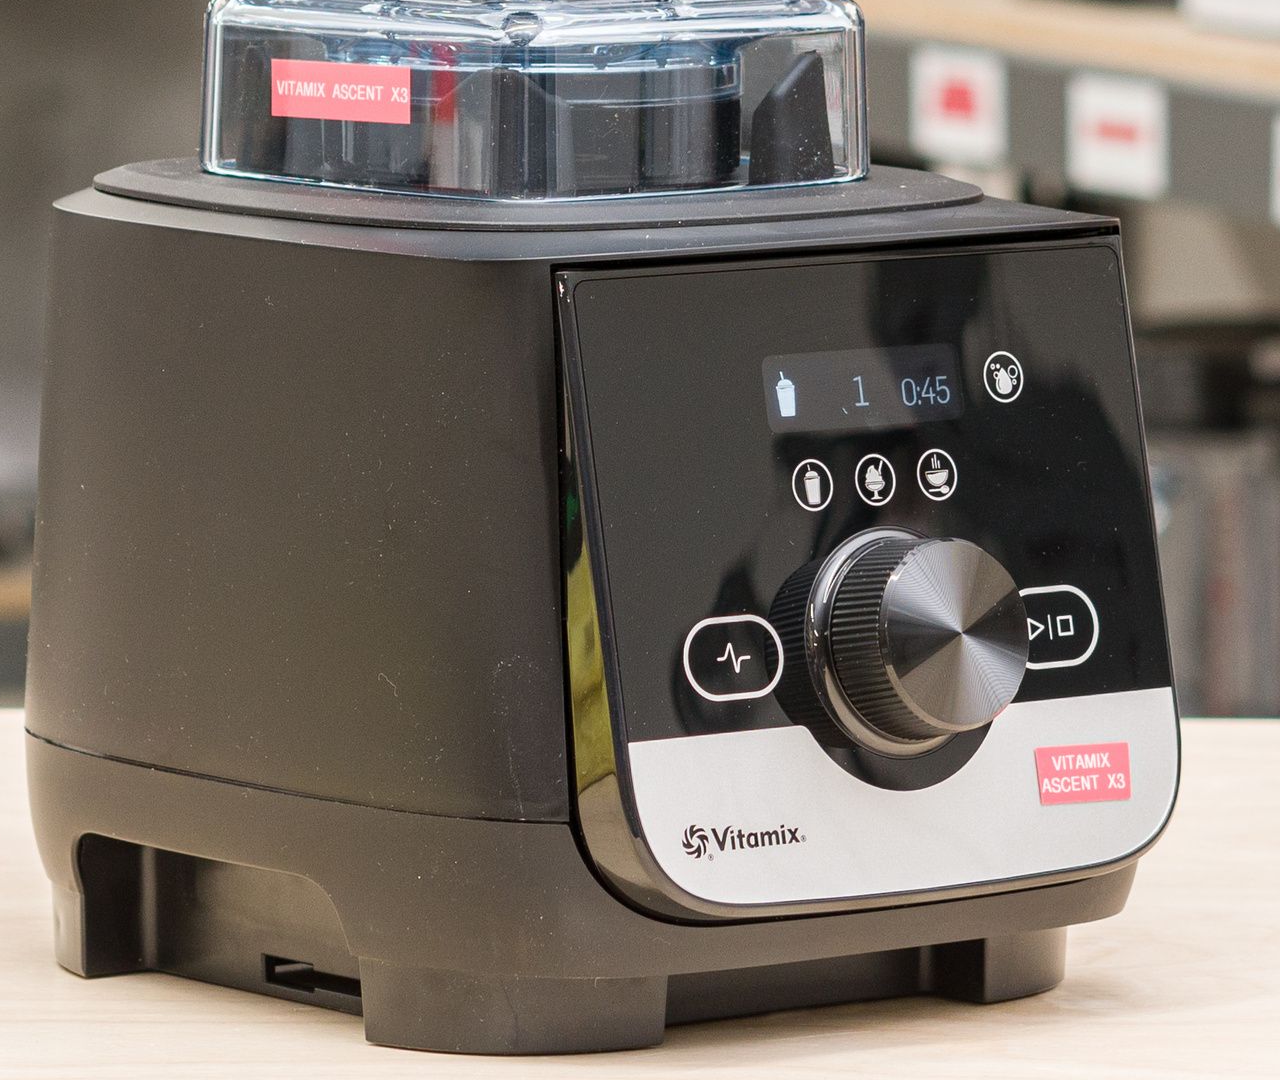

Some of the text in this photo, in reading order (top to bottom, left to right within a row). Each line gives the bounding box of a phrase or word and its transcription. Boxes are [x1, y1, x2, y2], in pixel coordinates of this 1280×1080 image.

[276, 79, 409, 103] VITAMIX ASCENT X3
[852, 375, 951, 408] 1 0:45
[1051, 752, 1111, 771] VITAMIX
[1042, 773, 1126, 794] ASCENT X3
